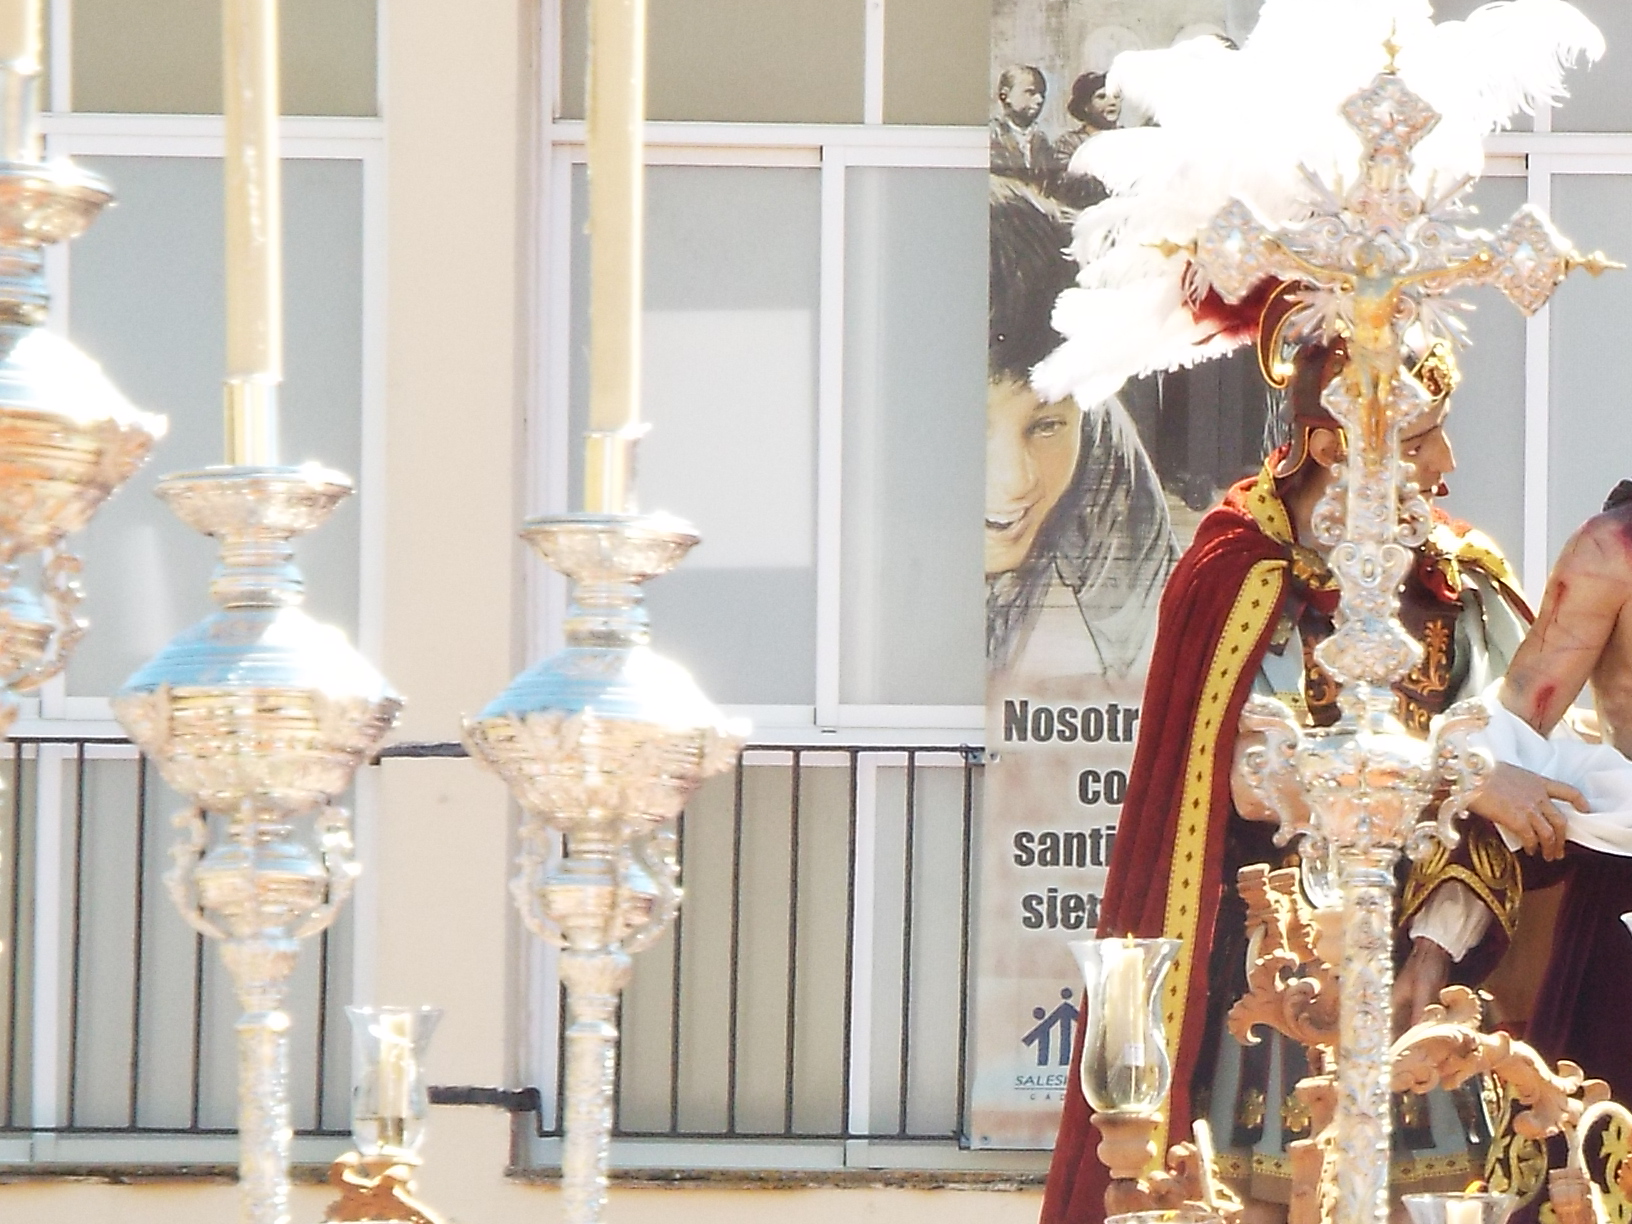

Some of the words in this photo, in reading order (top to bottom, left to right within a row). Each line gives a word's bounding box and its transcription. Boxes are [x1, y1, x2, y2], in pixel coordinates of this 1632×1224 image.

[1003, 699, 1140, 742] Nosotr
[1078, 769, 1128, 806] co
[1013, 825, 1117, 868] santi
